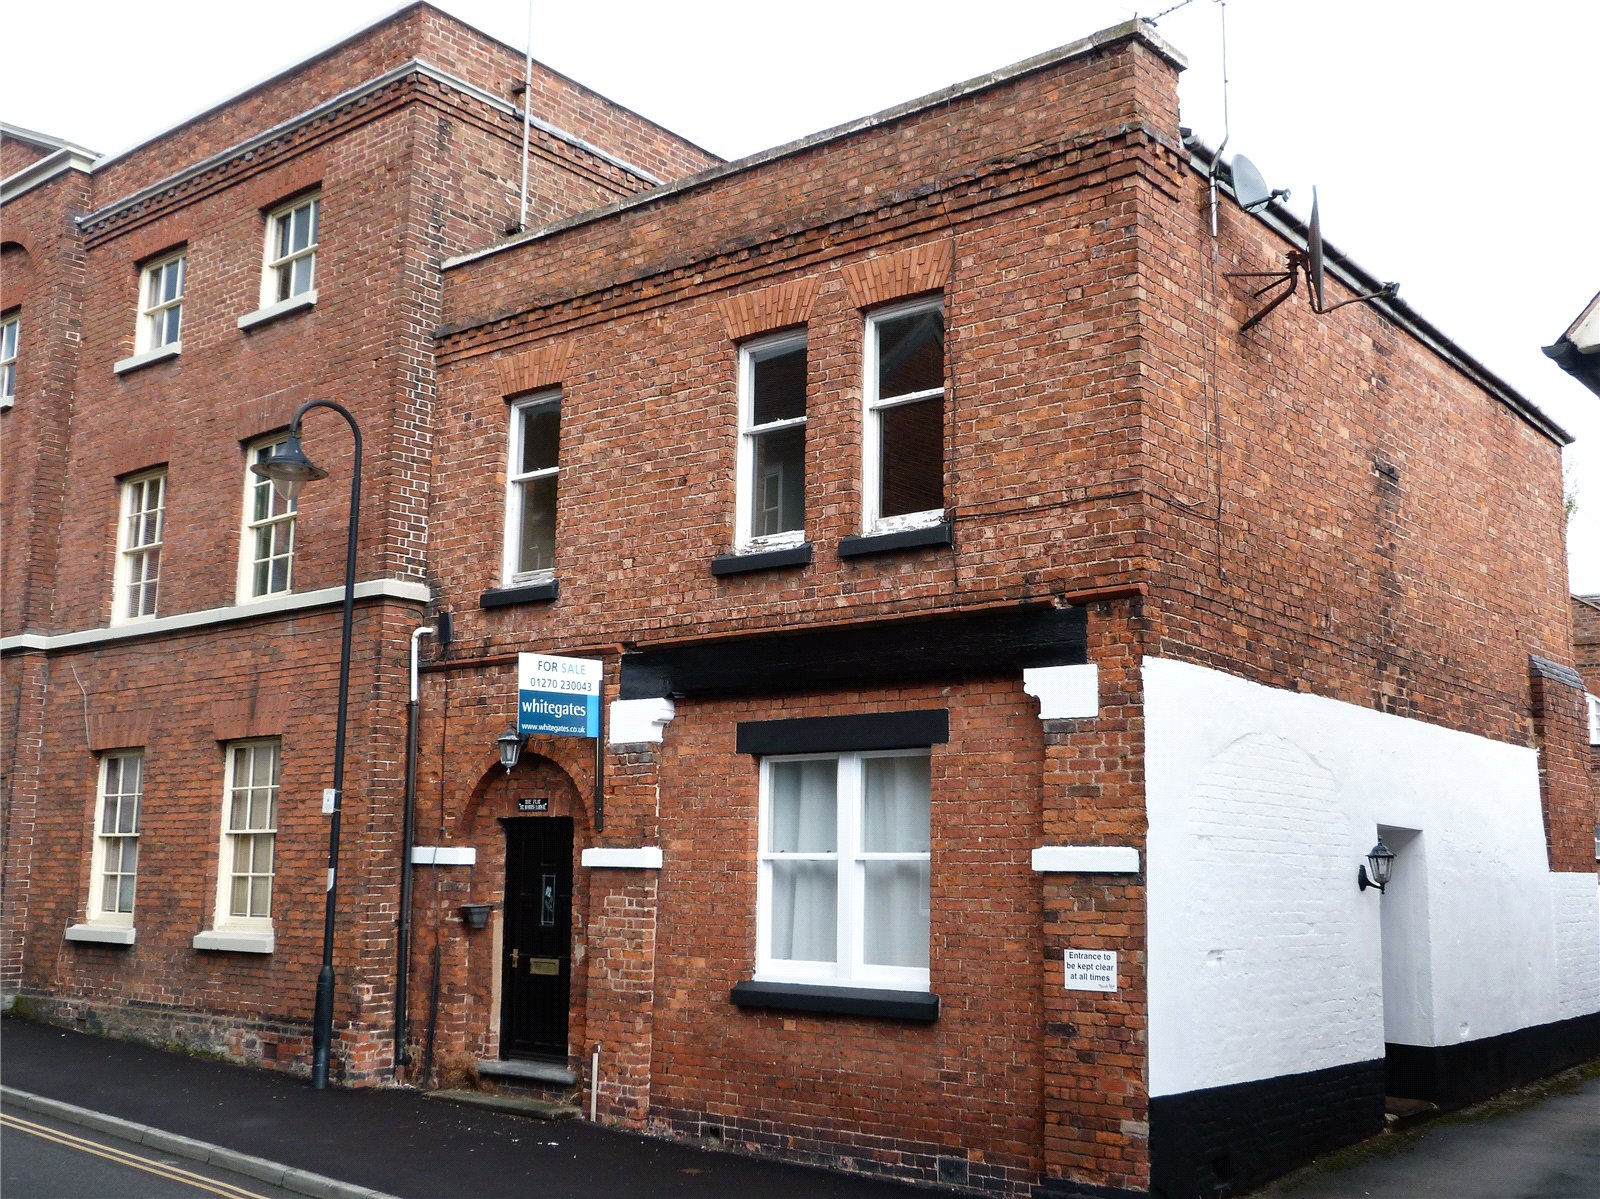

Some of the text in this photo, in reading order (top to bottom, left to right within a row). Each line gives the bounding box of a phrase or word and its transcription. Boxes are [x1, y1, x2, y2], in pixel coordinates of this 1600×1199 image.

[538, 660, 586, 675] FOR SALE
[530, 677, 592, 692] 01270 230043
[522, 698, 586, 718] whitegates
[521, 723, 586, 733] www.whitegates.co.uk
[1069, 951, 1101, 960] Entrance
[1066, 962, 1114, 972] be kept clear
[1079, 973, 1088, 981] all
